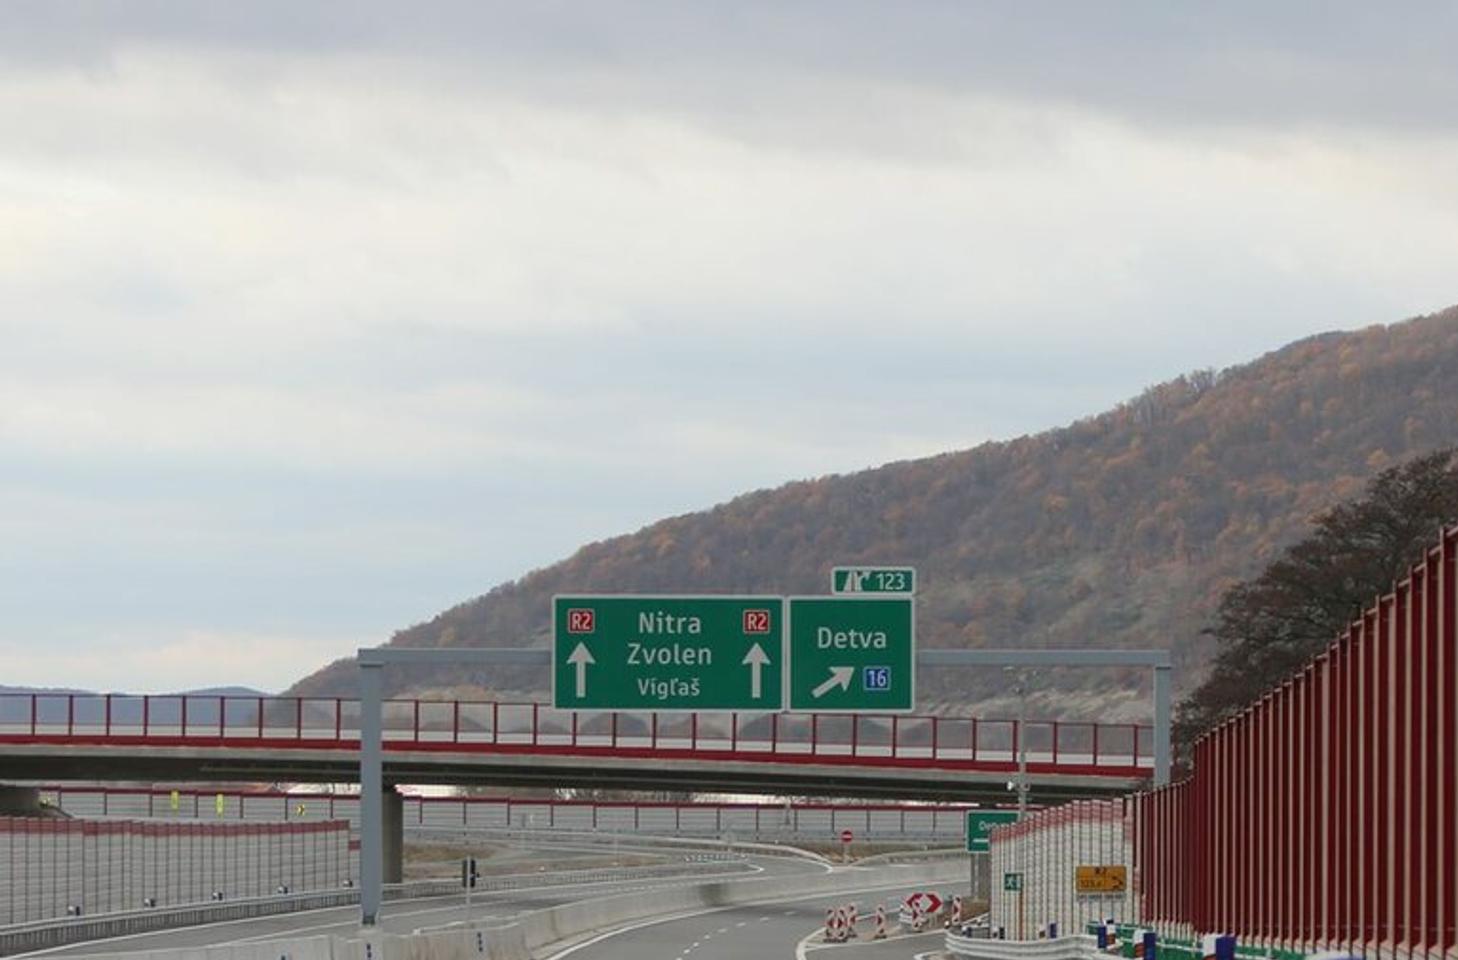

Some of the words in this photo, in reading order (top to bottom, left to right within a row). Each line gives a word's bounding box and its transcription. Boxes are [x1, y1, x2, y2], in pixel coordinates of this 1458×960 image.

[875, 573, 905, 591] 123
[571, 612, 592, 631] R2
[638, 611, 702, 634] Nitra
[746, 613, 767, 631] R2
[817, 626, 887, 649] Detva
[627, 643, 712, 665] Zvolen
[868, 669, 887, 687] 16
[637, 677, 701, 700] Vígľaš
